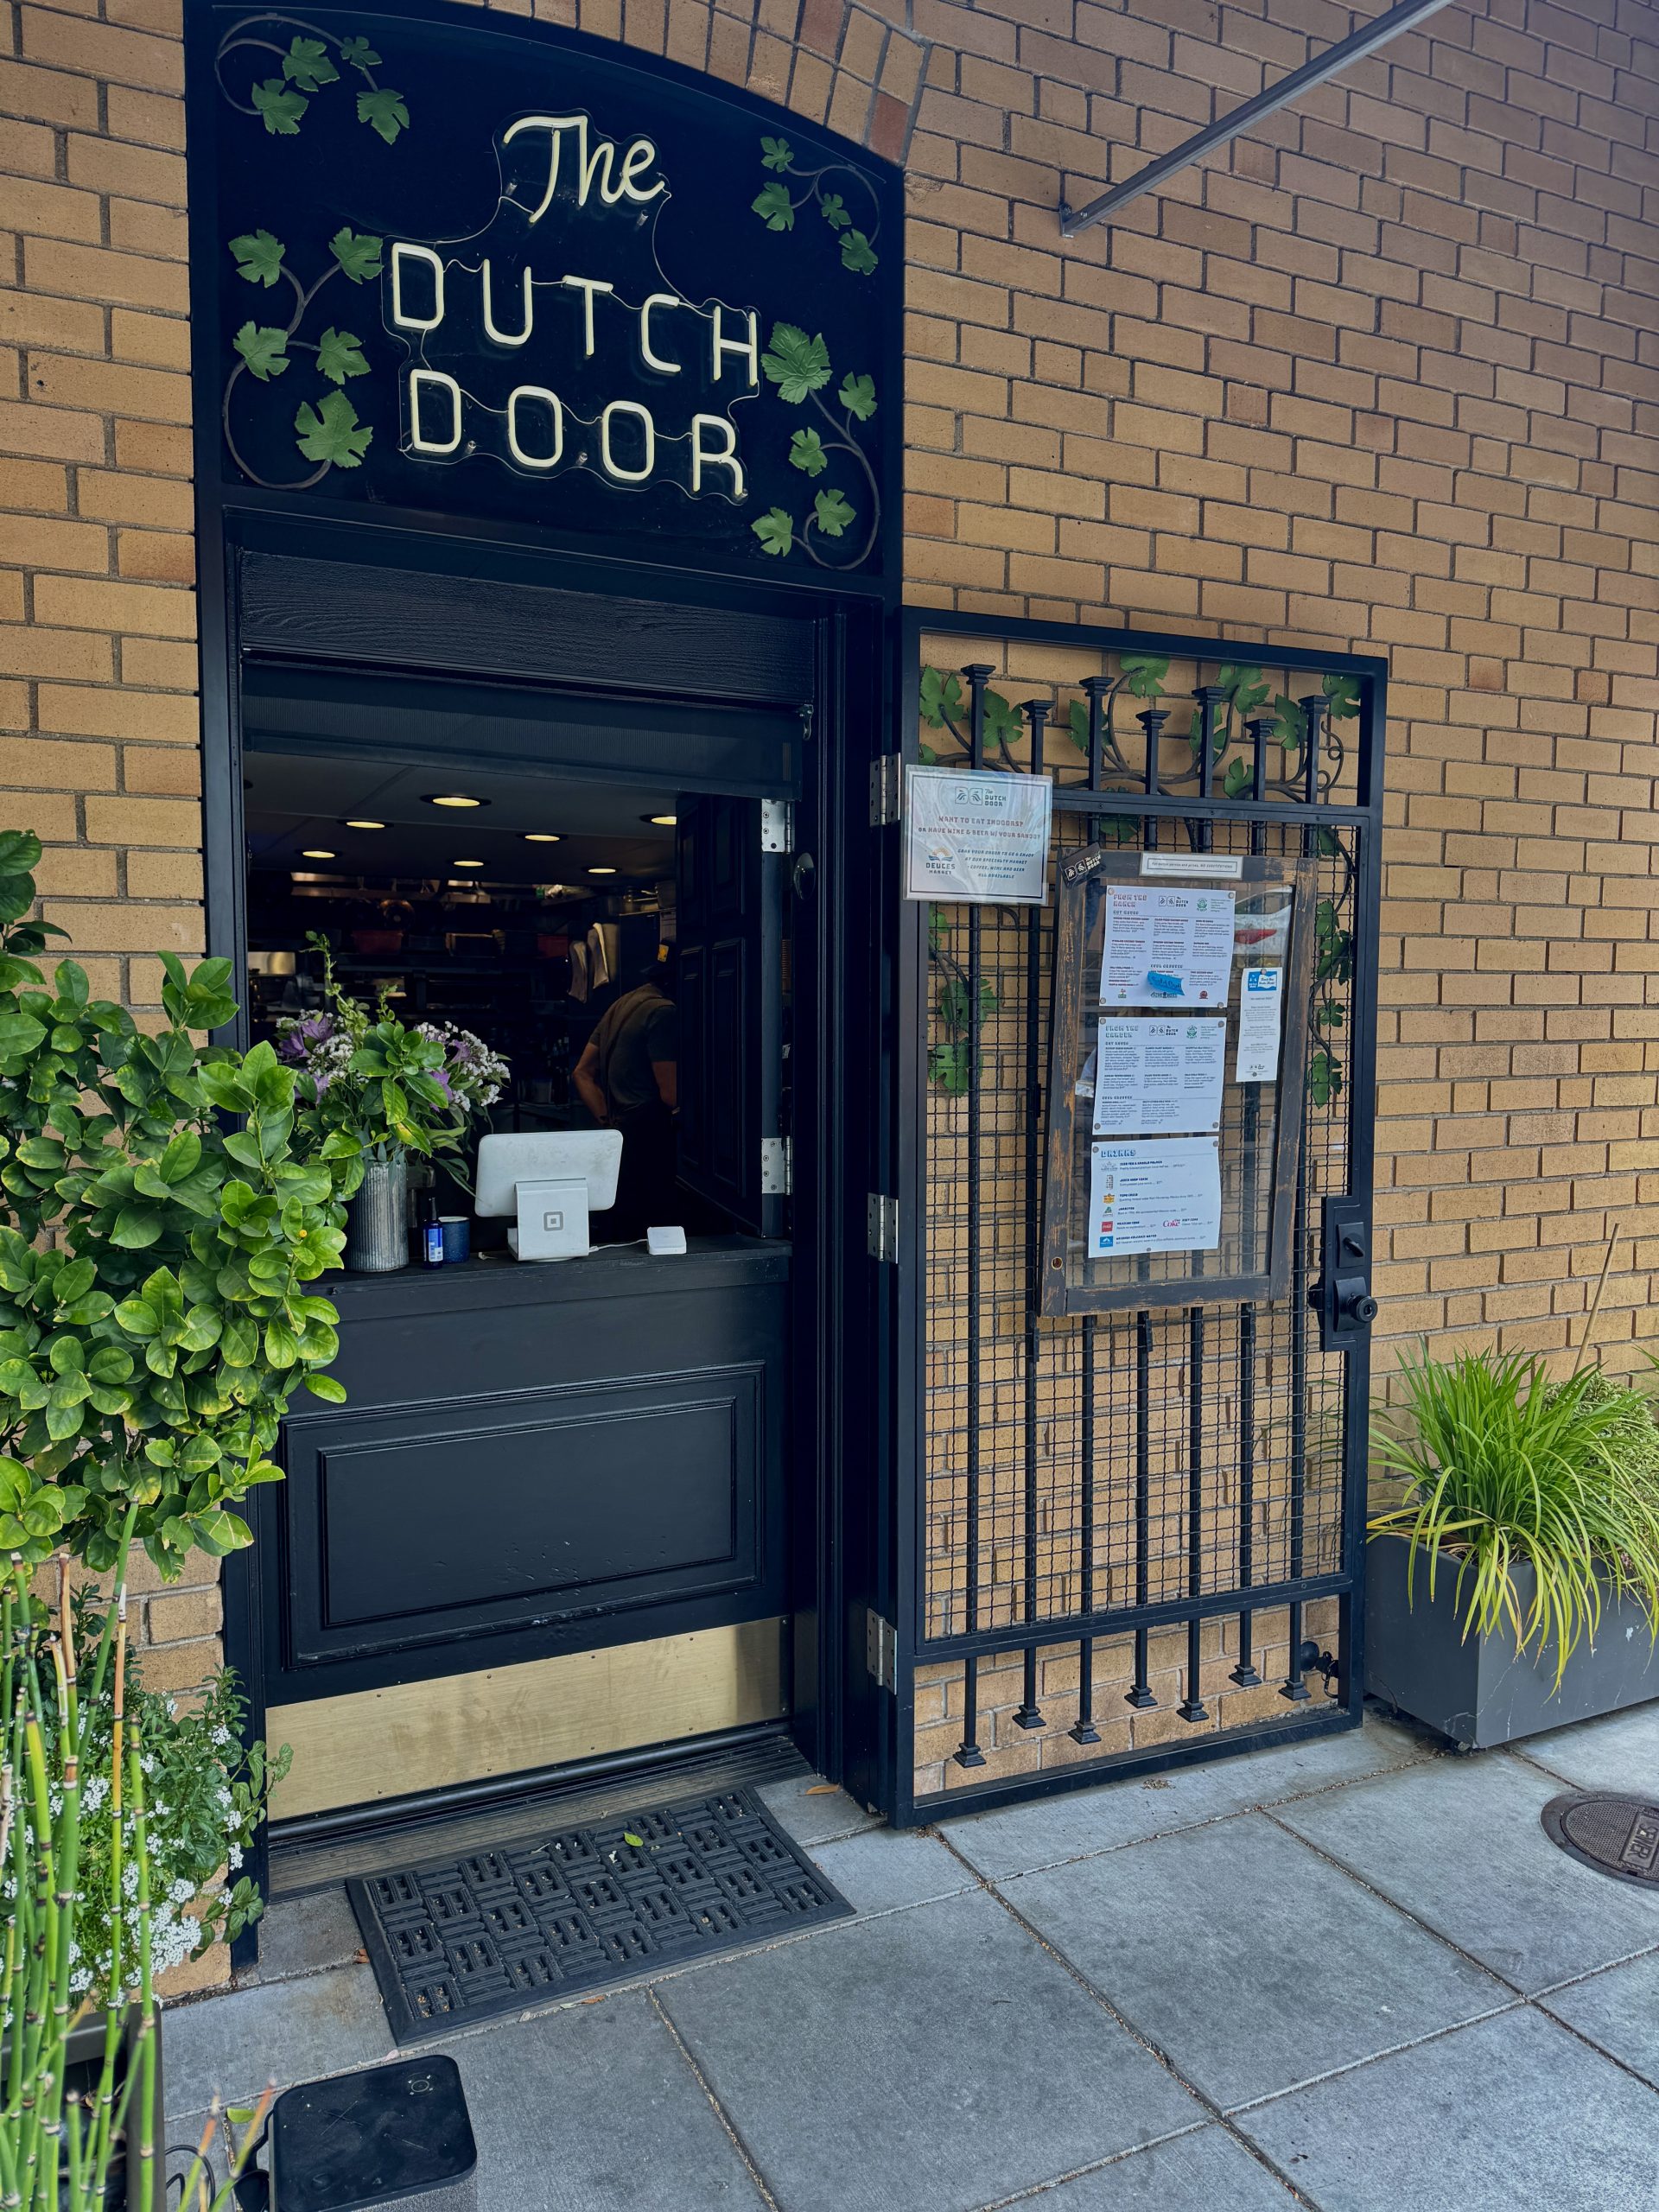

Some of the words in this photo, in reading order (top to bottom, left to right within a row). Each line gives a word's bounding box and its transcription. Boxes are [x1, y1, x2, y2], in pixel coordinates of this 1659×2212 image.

[504, 116, 665, 223] The
[391, 242, 758, 387] DUTCH
[409, 369, 743, 497] DOOR
[1101, 1149, 1136, 1158] DRINKS
